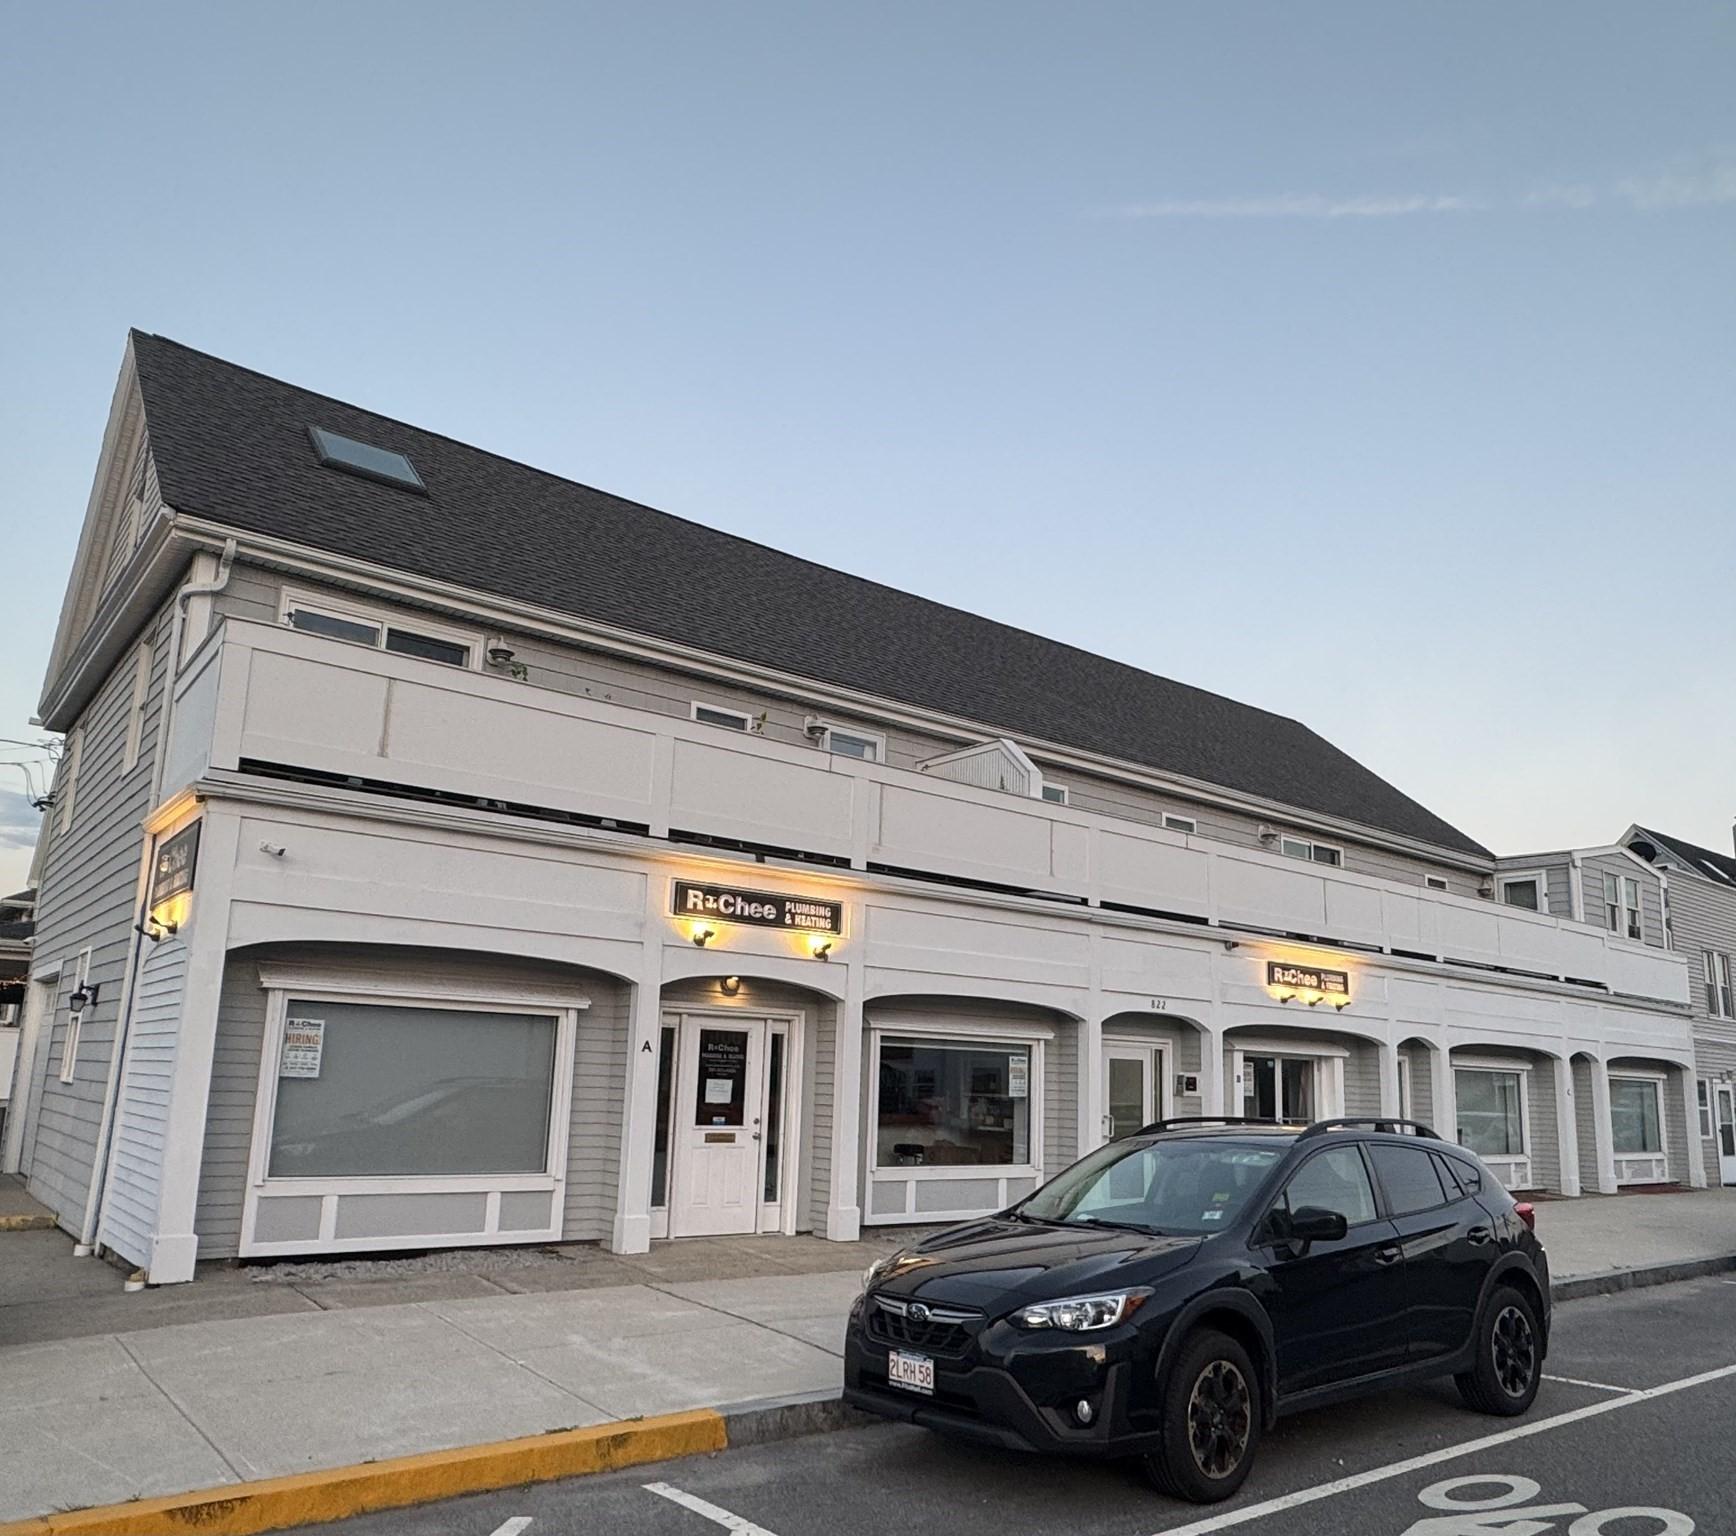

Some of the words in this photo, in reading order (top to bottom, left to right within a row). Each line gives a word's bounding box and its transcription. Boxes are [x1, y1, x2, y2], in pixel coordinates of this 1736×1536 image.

[784, 901, 832, 918] PLUMBING
[784, 915, 792, 925] &
[794, 916, 832, 930] HEATING
[641, 1040, 653, 1053] A
[890, 1358, 916, 1382] 2LRH
[918, 1364, 932, 1385] 58
